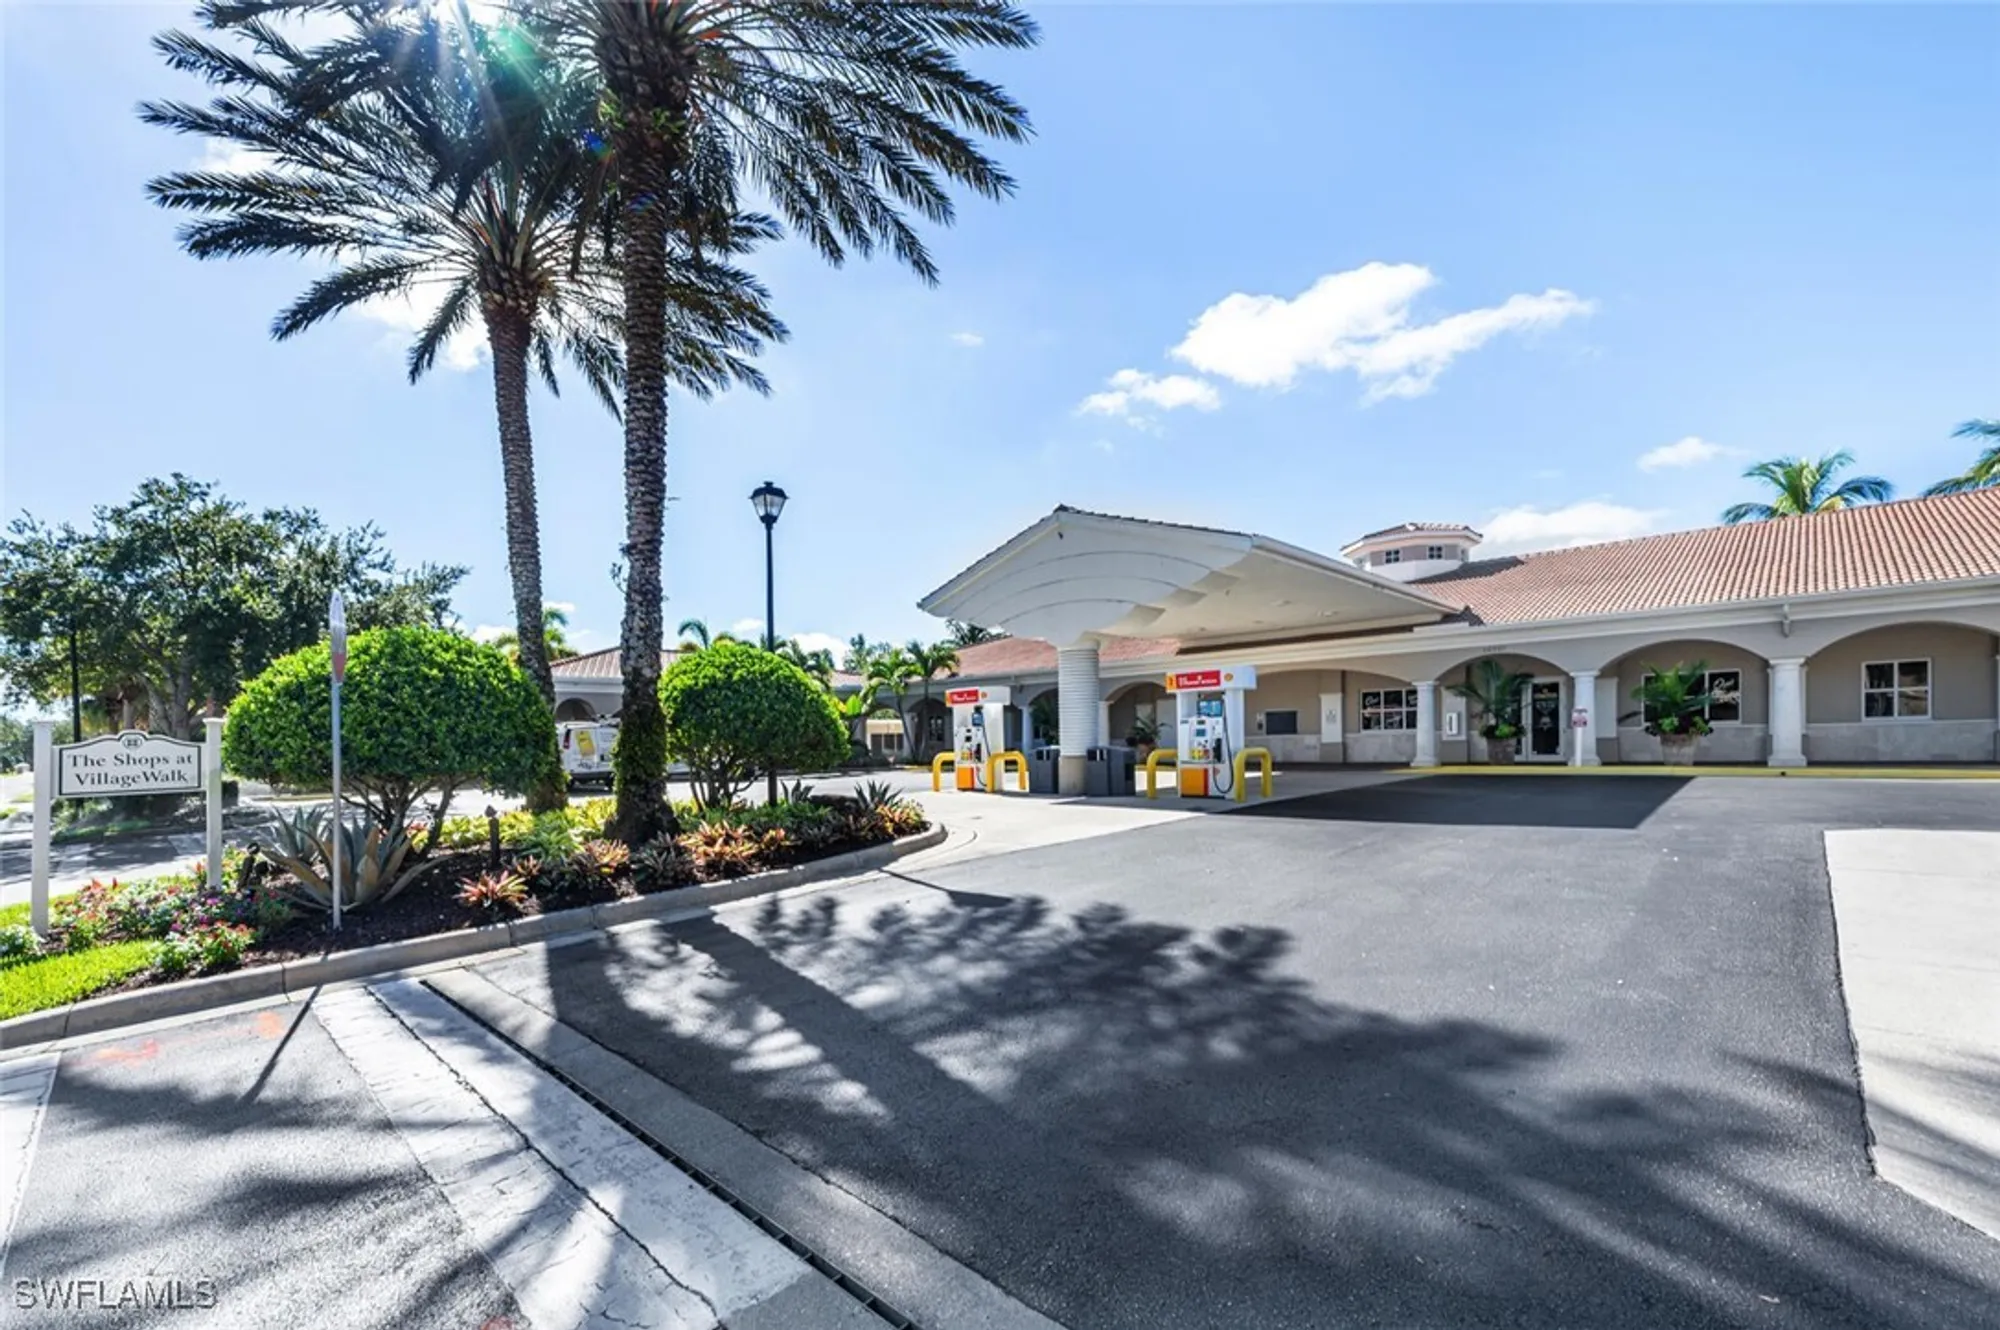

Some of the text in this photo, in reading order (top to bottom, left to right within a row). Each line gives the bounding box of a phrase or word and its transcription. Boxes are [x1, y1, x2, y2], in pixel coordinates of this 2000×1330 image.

[67, 753, 193, 769] The Shops at
[75, 769, 189, 788] VillageWalk
